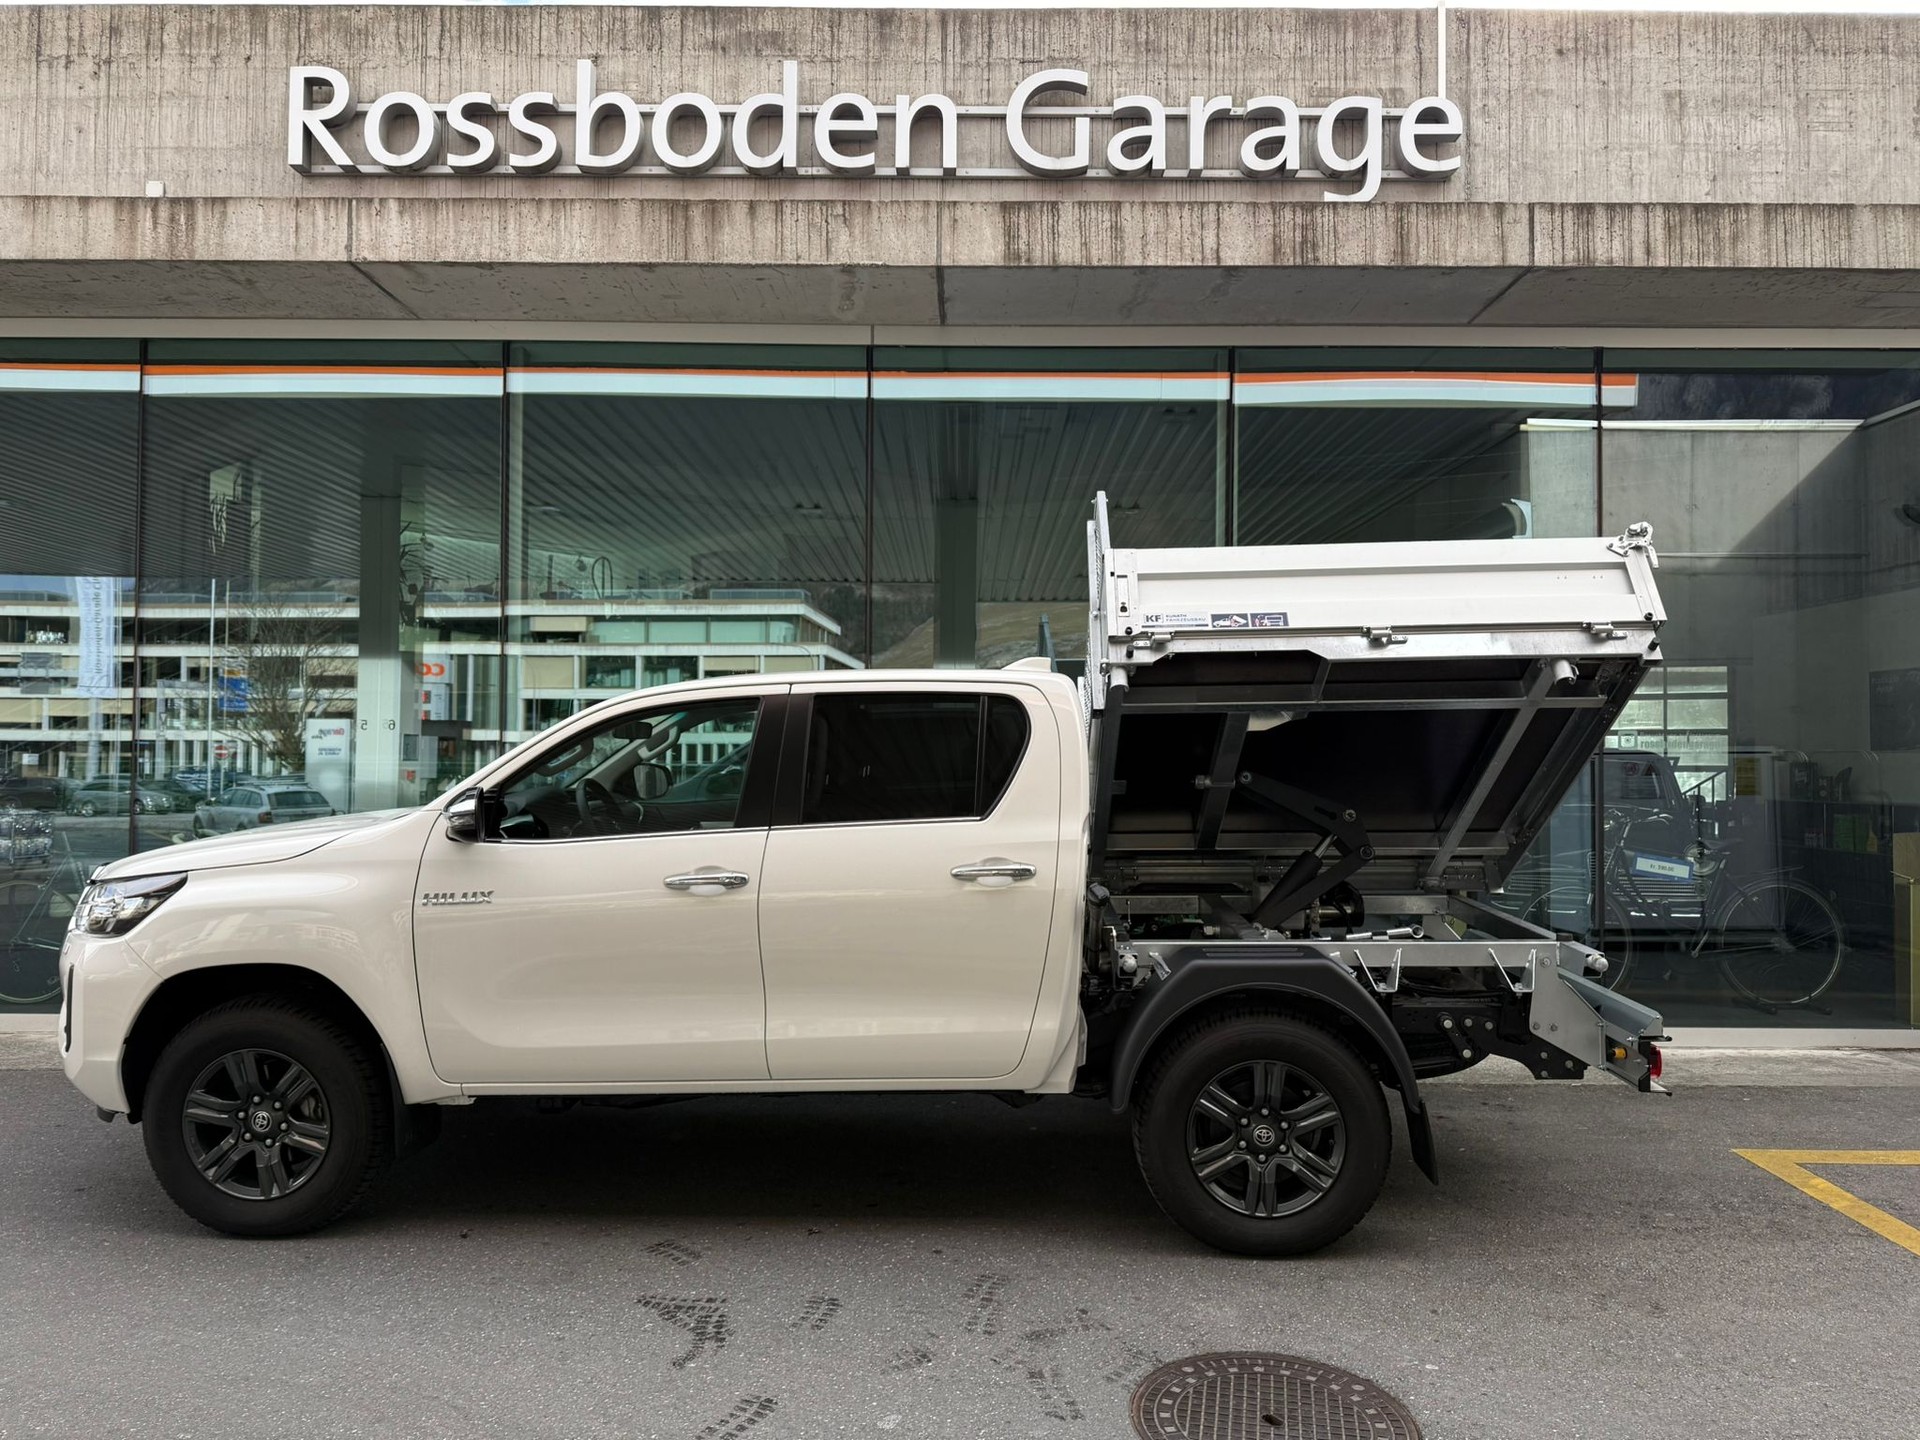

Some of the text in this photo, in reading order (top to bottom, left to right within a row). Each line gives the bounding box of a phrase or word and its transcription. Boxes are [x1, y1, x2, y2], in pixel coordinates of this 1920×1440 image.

[287, 59, 1464, 202] Rossboden Garage
[1145, 614, 1161, 623] KF
[422, 890, 495, 906] HILUX
